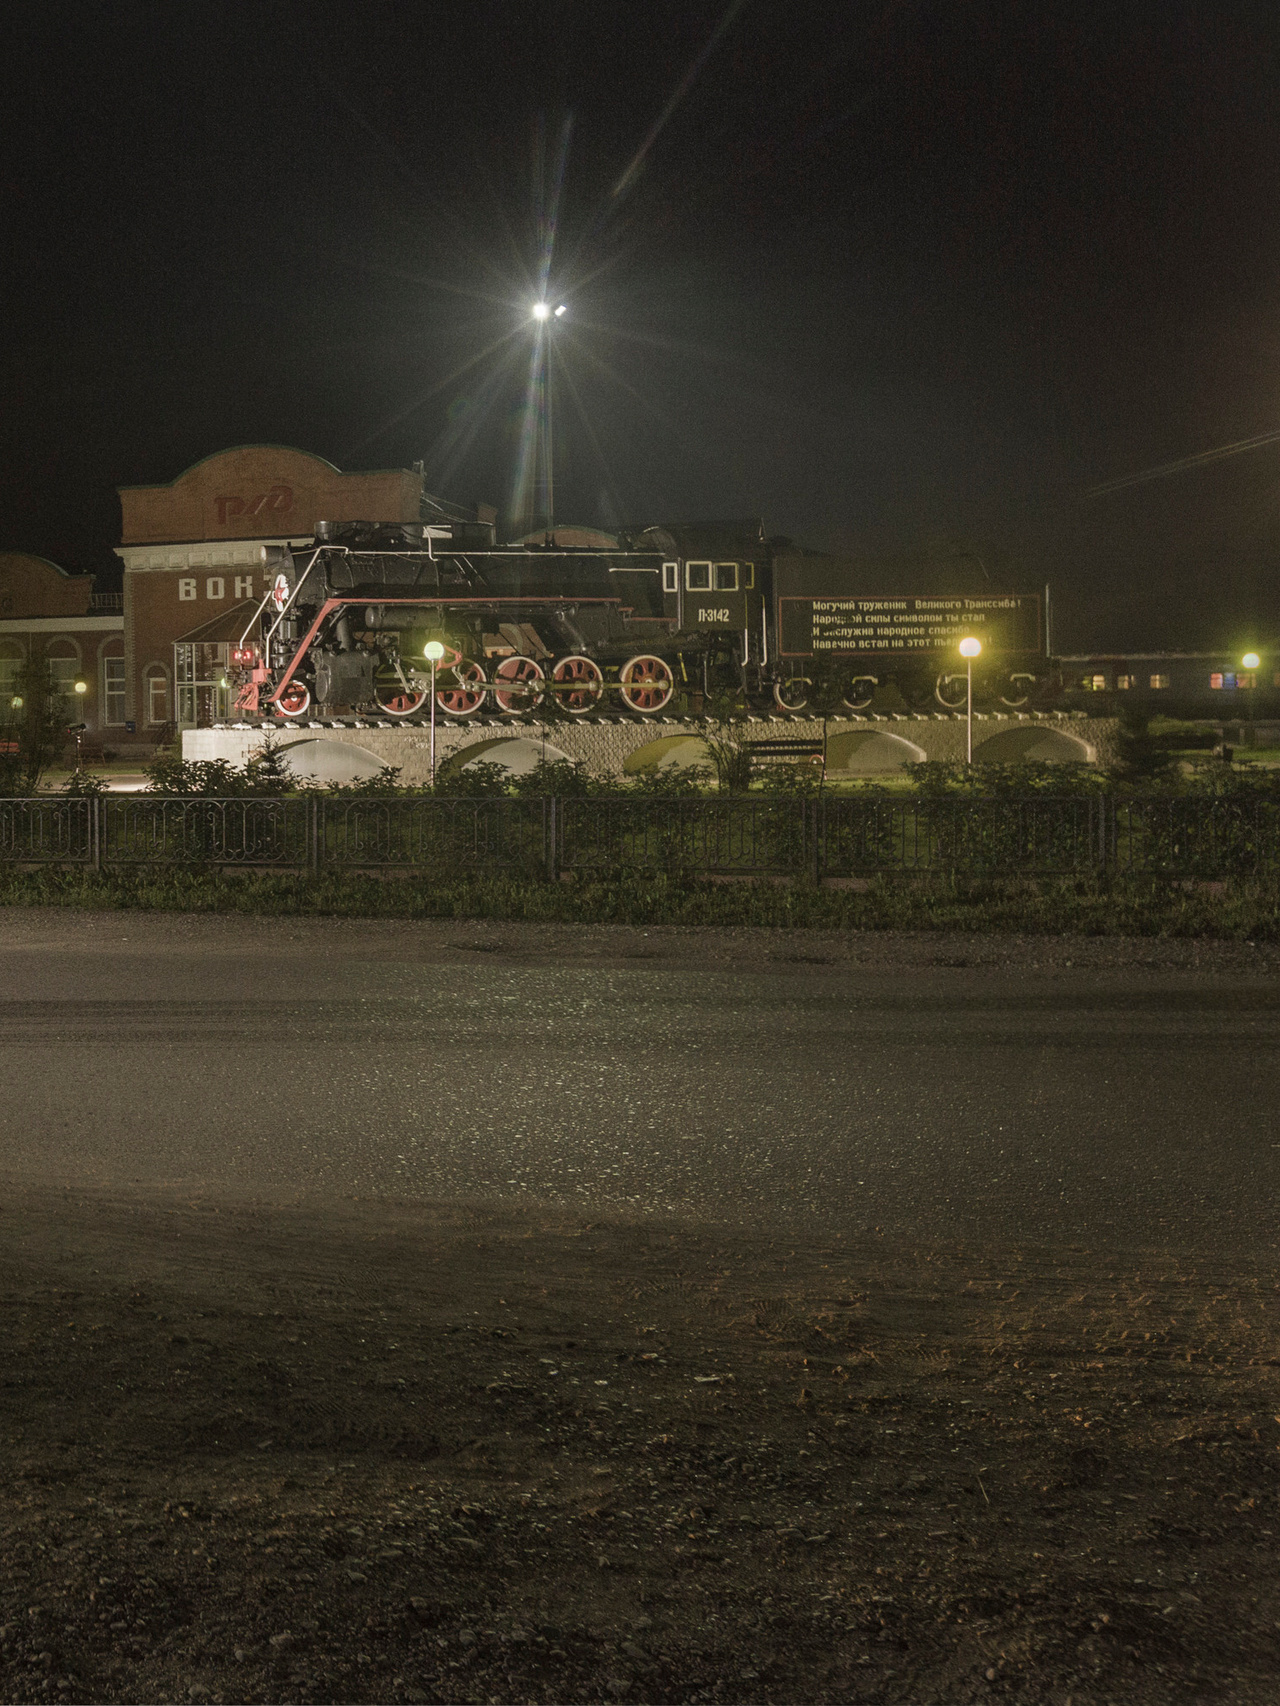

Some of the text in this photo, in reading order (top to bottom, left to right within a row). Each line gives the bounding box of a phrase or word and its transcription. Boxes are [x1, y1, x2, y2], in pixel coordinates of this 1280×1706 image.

[813, 600, 855, 612] Могучий
[858, 601, 907, 612] труженик
[915, 599, 961, 609] Великого
[865, 614, 890, 623] силы
[893, 614, 942, 623] символом
[945, 614, 958, 622] ты
[962, 613, 985, 622] стал
[813, 627, 820, 636] И
[877, 627, 925, 637] народное
[928, 625, 970, 635] спасибо
[813, 639, 856, 649] Навечно
[859, 639, 888, 648] встал
[891, 639, 903, 648] на
[907, 638, 930, 647] этот
